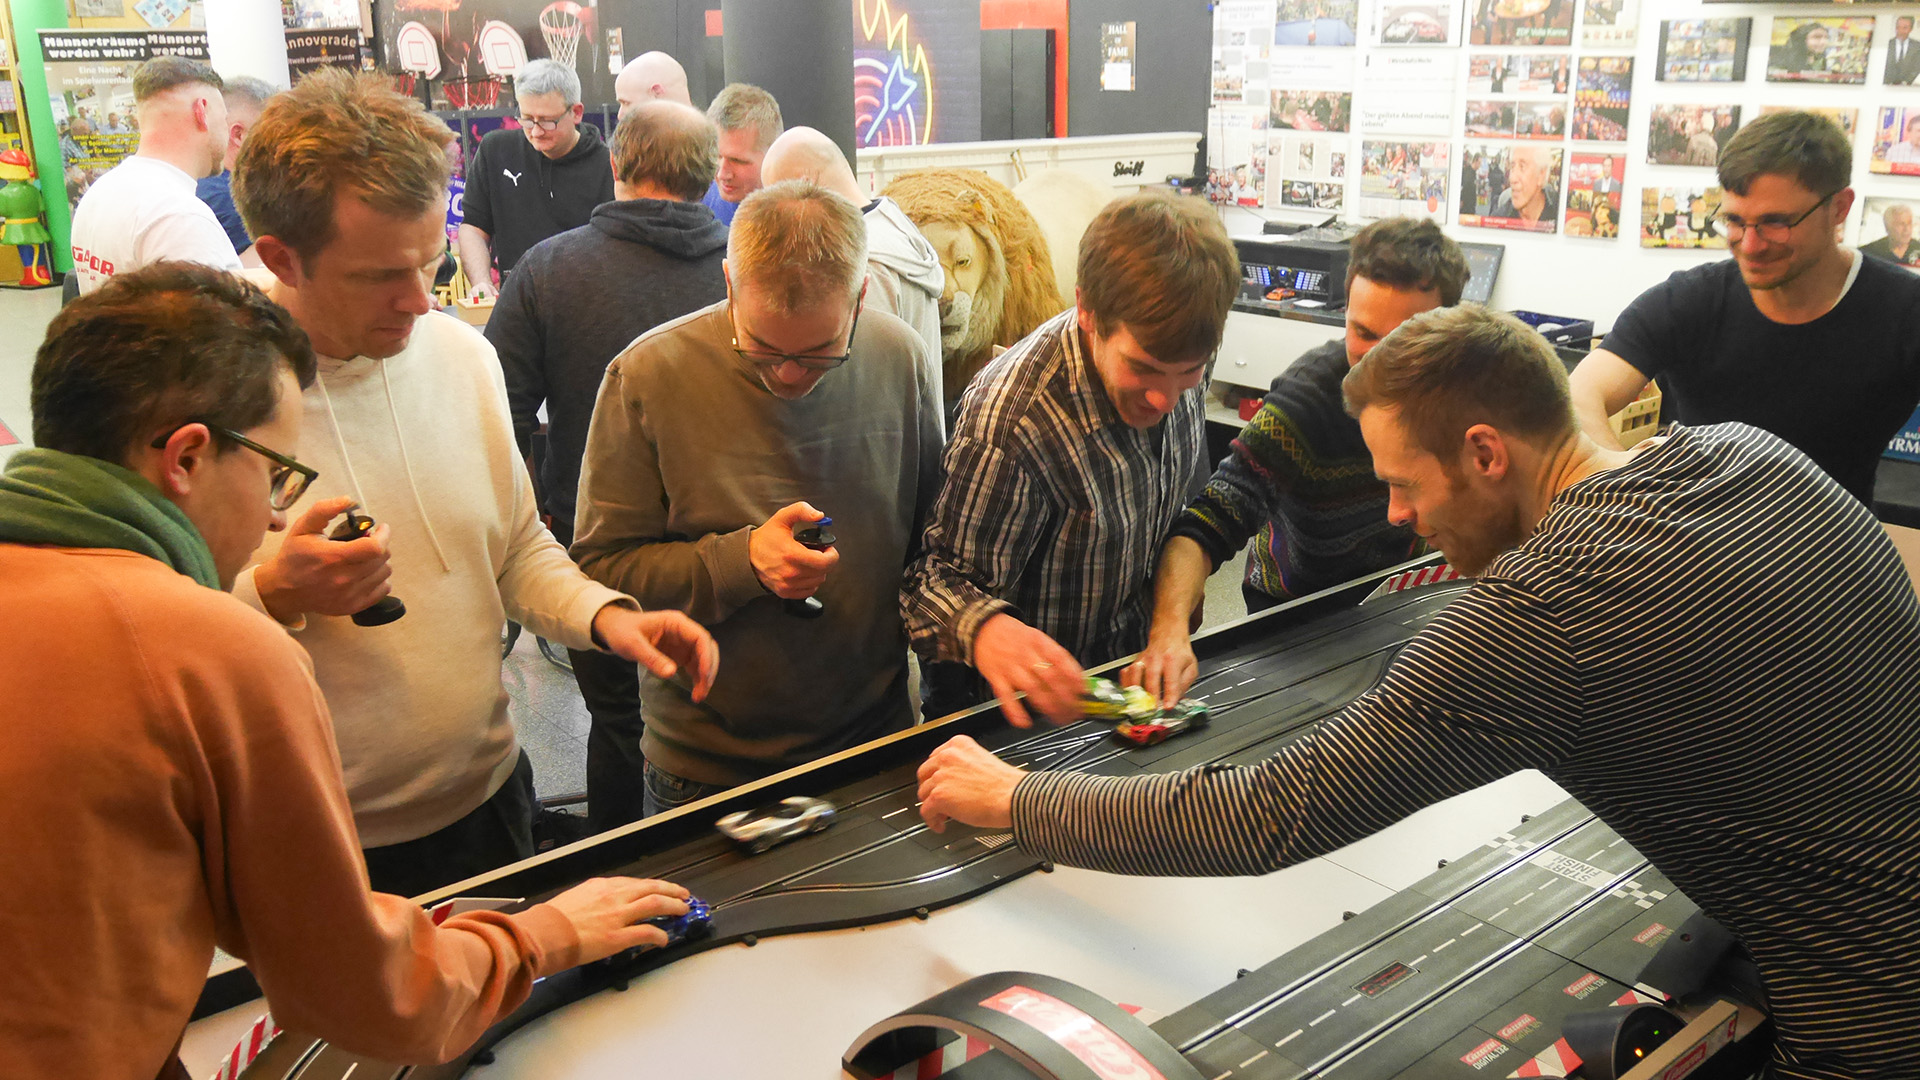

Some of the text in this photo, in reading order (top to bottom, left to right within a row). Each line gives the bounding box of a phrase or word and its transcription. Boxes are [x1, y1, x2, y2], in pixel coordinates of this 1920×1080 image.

[1108, 25, 1127, 35] HALL
[44, 37, 146, 48] Männerträume
[151, 45, 203, 56] werden
[49, 48, 99, 58] werden
[103, 48, 137, 58] wahr
[1108, 46, 1129, 57] FAME
[79, 66, 121, 74] Eine Nacht
[1113, 160, 1145, 177] Steiff
[1888, 437, 1920, 454] YRM
[1544, 862, 1590, 882] START
[1553, 855, 1602, 877] FINISH
[1567, 975, 1596, 993] Carrera
[1501, 1015, 1532, 1037] Carrera
[1465, 1040, 1499, 1063] Carrera
[1472, 1044, 1510, 1071] DIGITAL 132
